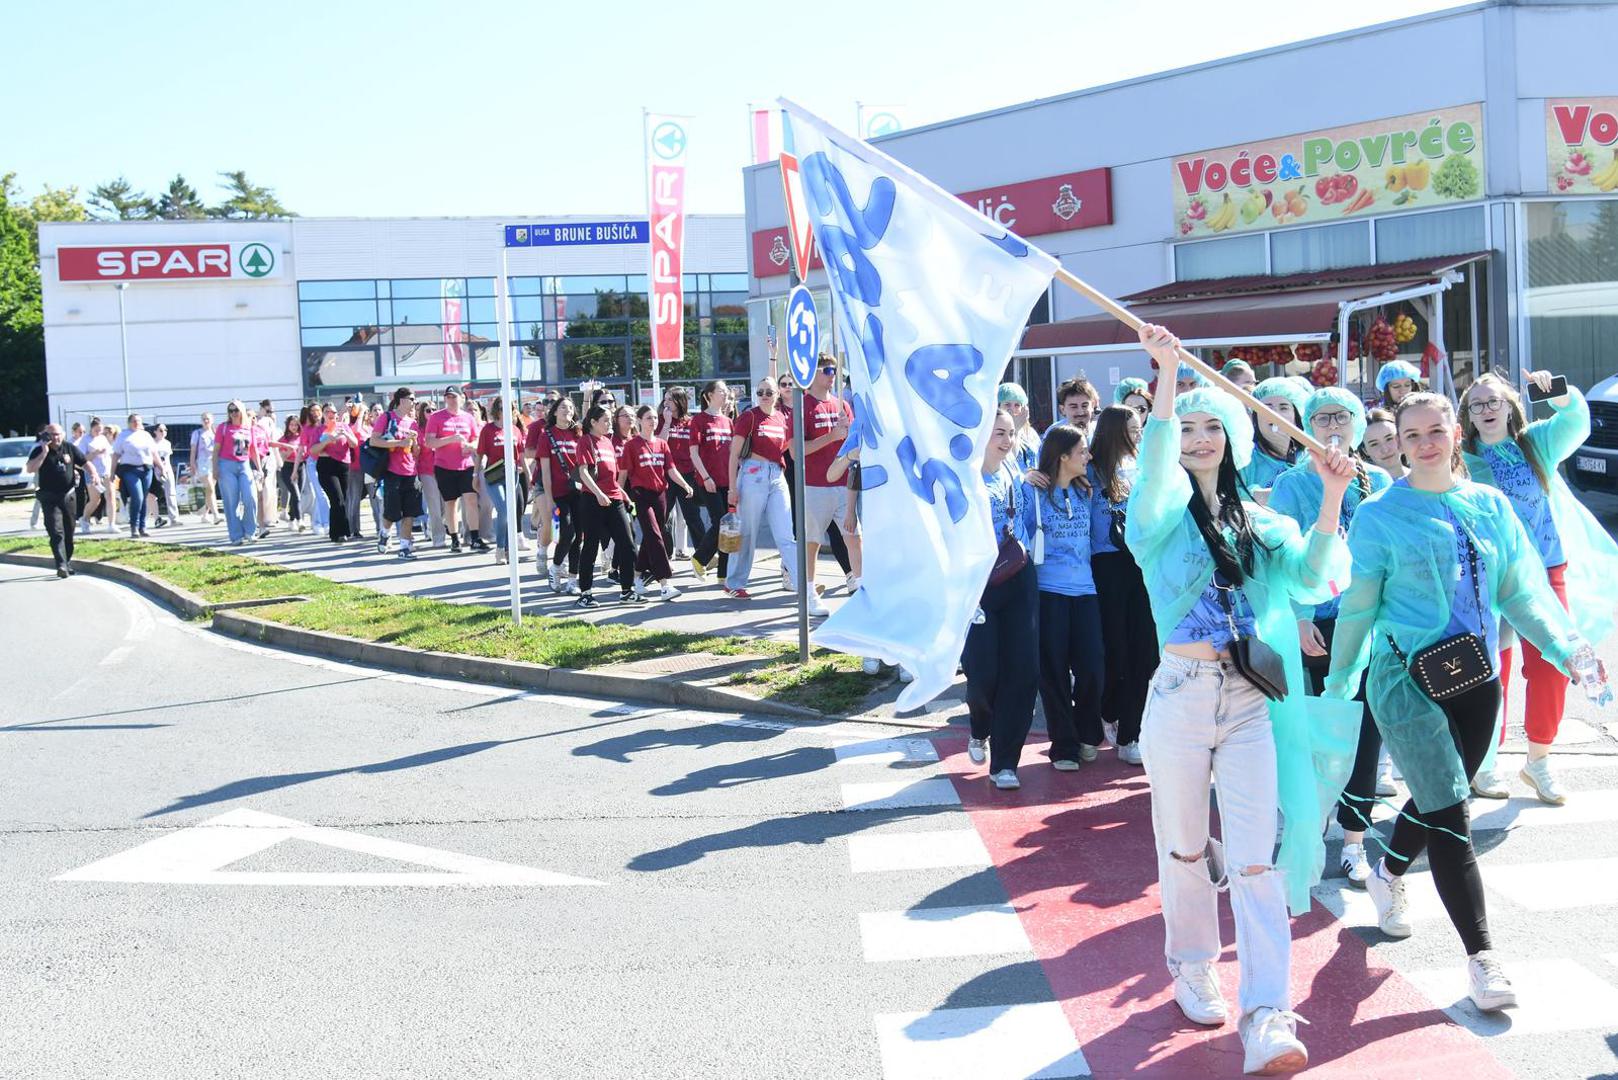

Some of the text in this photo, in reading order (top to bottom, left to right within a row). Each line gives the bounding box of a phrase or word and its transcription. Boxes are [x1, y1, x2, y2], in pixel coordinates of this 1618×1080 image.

[534, 223, 638, 242] ULICA BRUNE BUŠIĆA
[654, 172, 679, 325] SPAR
[97, 249, 228, 276] SPAR
